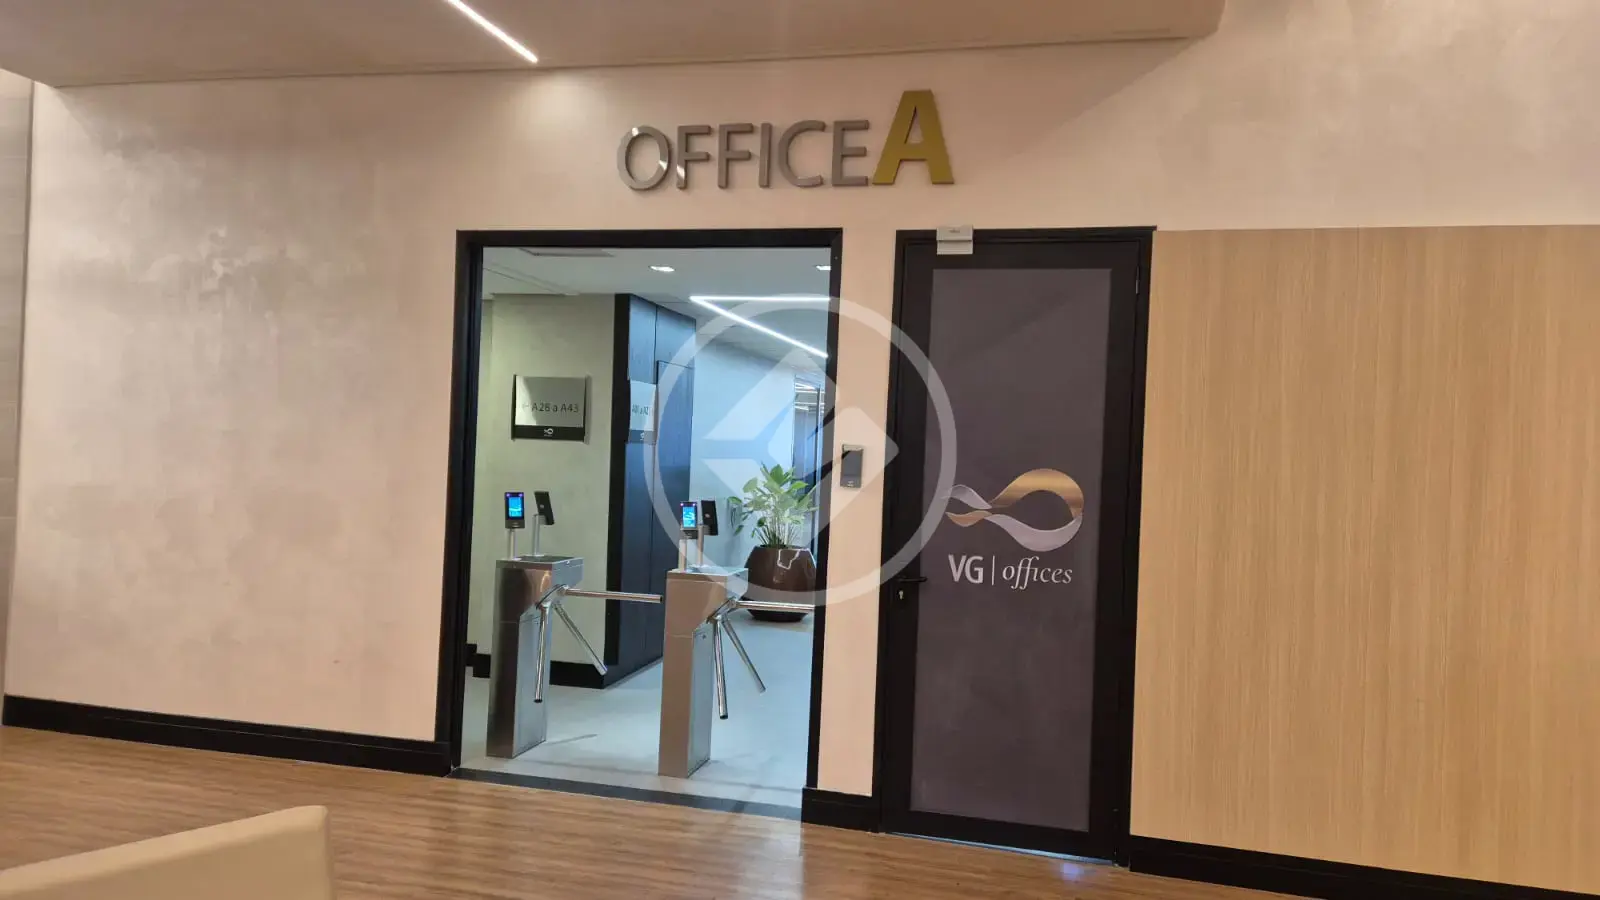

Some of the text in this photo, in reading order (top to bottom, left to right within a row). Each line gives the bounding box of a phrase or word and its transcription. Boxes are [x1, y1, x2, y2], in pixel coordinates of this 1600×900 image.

[553, 404, 558, 412] a
[948, 554, 1073, 590] VG offices
